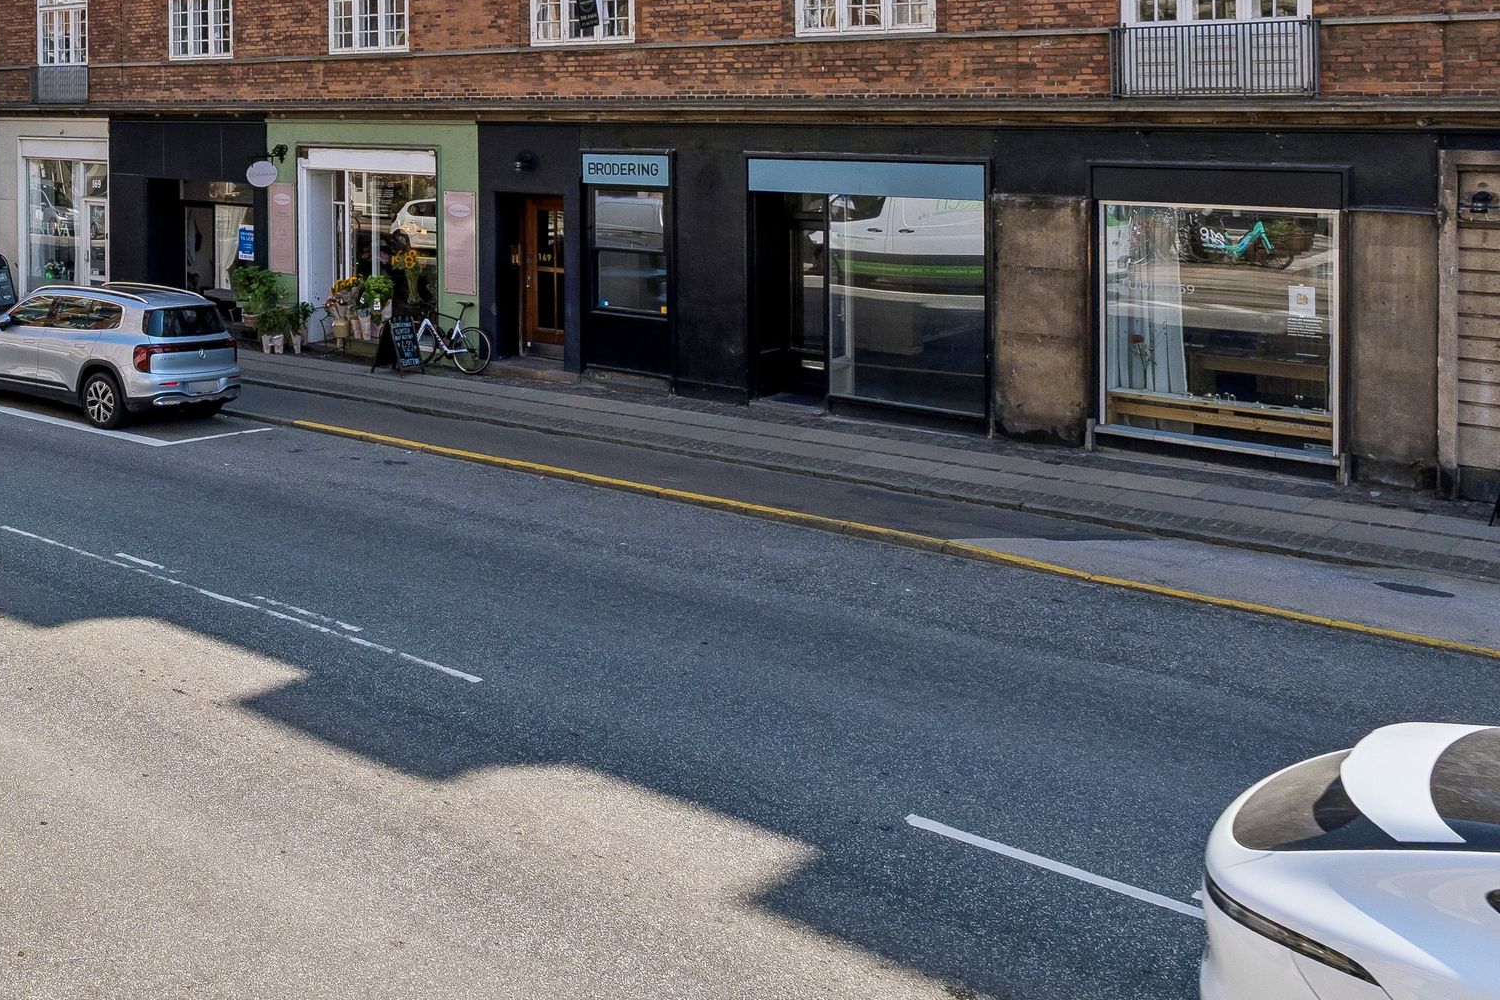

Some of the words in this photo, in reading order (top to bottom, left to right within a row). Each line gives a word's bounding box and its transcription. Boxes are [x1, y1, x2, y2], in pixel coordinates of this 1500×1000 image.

[587, 162, 659, 177] BRODERING
[91, 179, 102, 189] 169
[538, 252, 552, 262] 169
[1219, 415, 1253, 425] SHOWROOM
